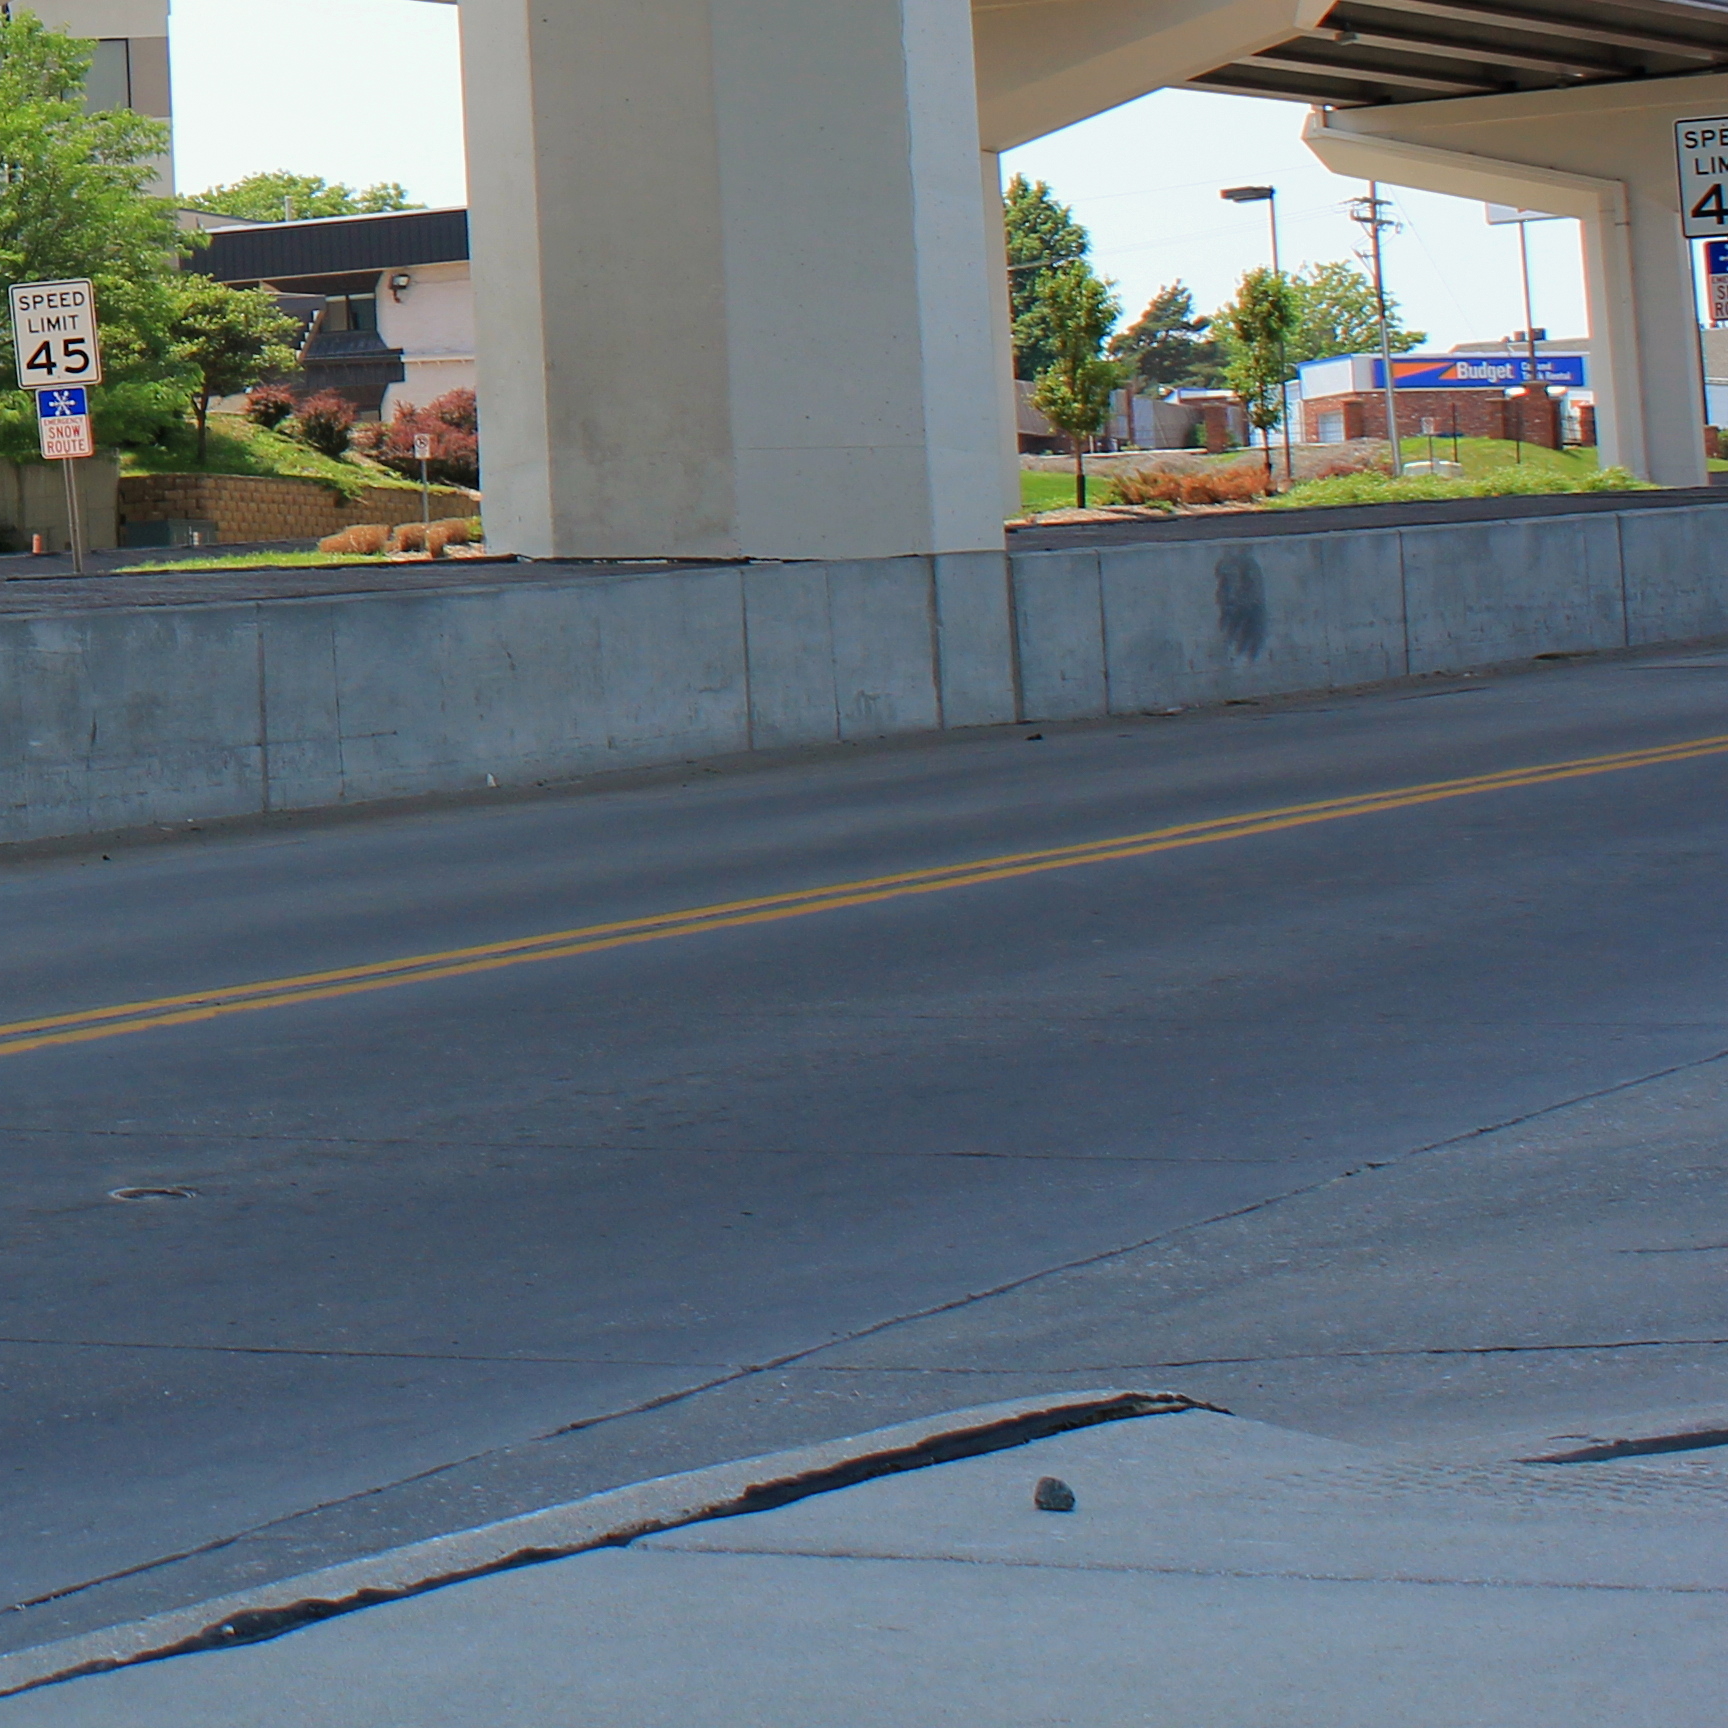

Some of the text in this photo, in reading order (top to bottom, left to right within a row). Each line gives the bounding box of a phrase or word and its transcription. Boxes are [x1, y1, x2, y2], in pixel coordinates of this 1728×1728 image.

[1690, 183, 1728, 225] 4
[18, 291, 85, 311] SPEED
[27, 314, 79, 333] LIMIT
[26, 337, 90, 376] 45
[1456, 361, 1515, 383] Budget
[44, 417, 83, 426] EMERGENCY
[48, 425, 81, 439] SNOW
[47, 439, 85, 454] ROUTE
